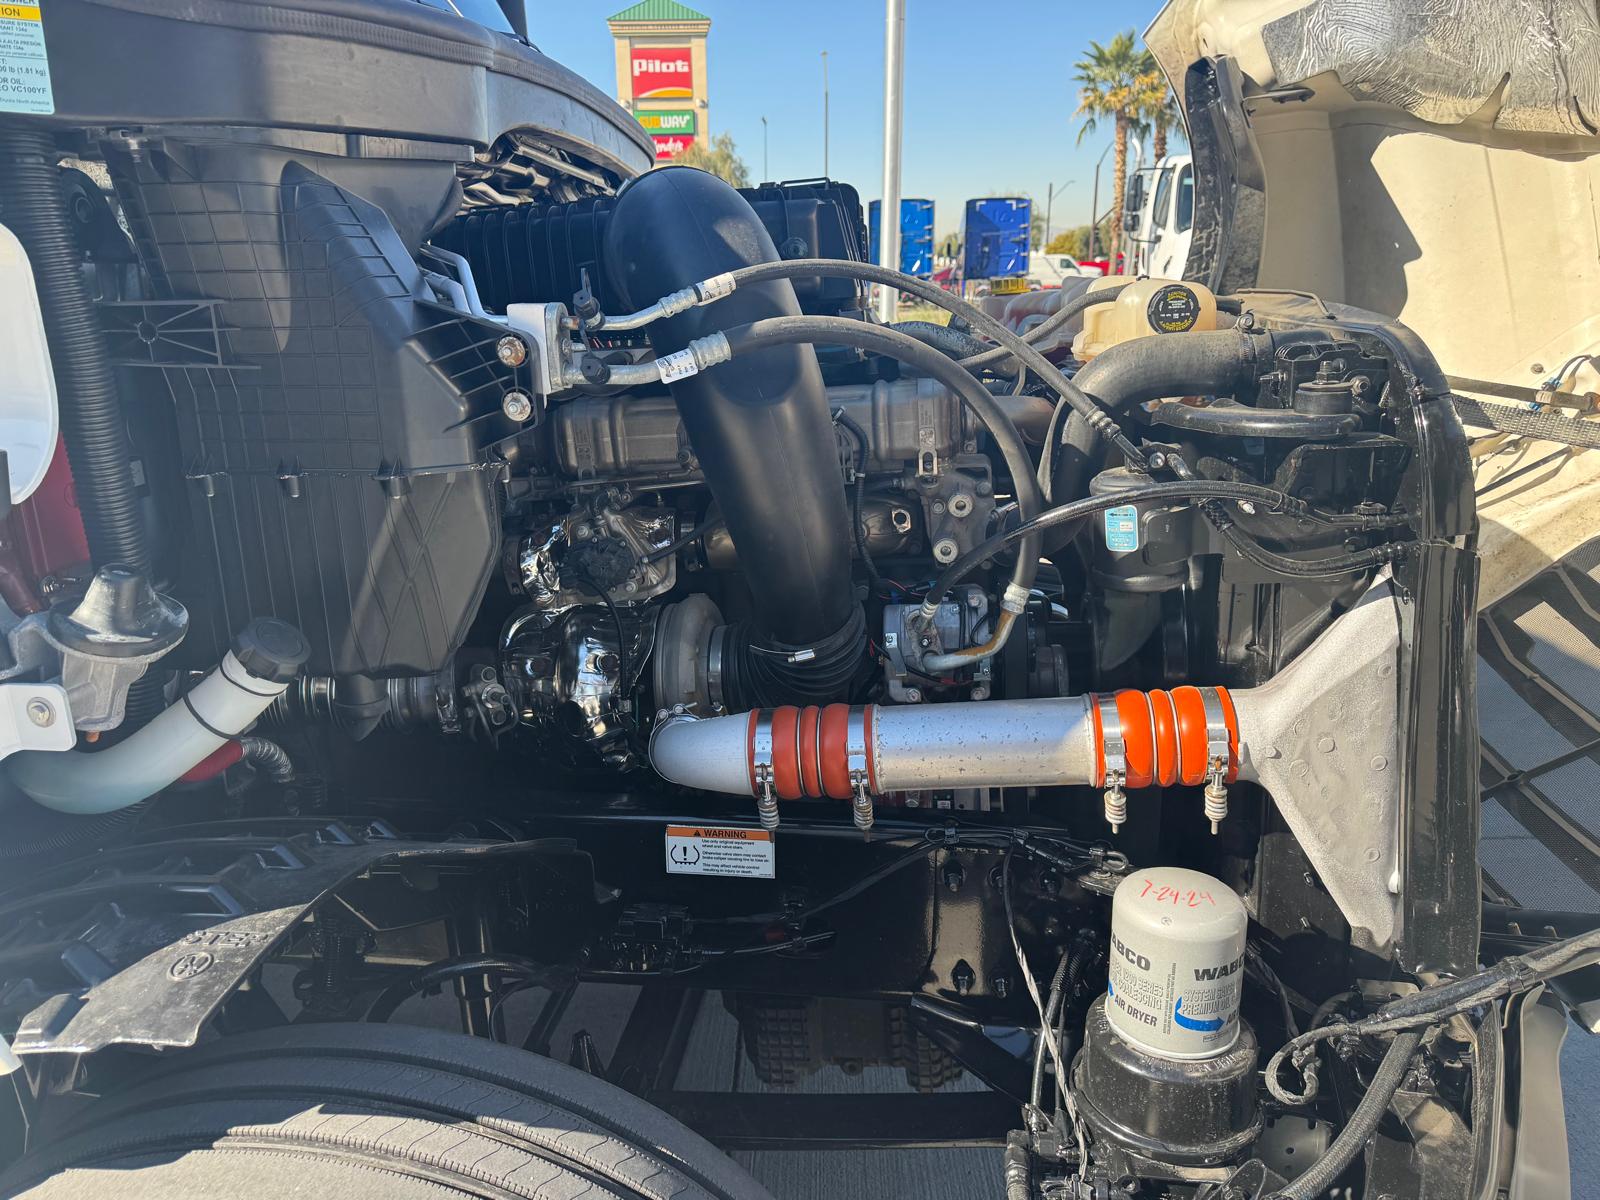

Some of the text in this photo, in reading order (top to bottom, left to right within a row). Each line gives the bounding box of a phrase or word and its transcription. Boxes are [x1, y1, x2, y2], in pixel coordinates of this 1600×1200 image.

[633, 59, 689, 77] Pilot
[10, 85, 47, 95] VC100YF
[639, 115, 690, 129] SUBWAY
[704, 829, 747, 839] WARNING
[1183, 987, 1216, 1004] SYSTEM
[1114, 993, 1126, 1010] AIR
[1127, 1004, 1158, 1028] DRYER
